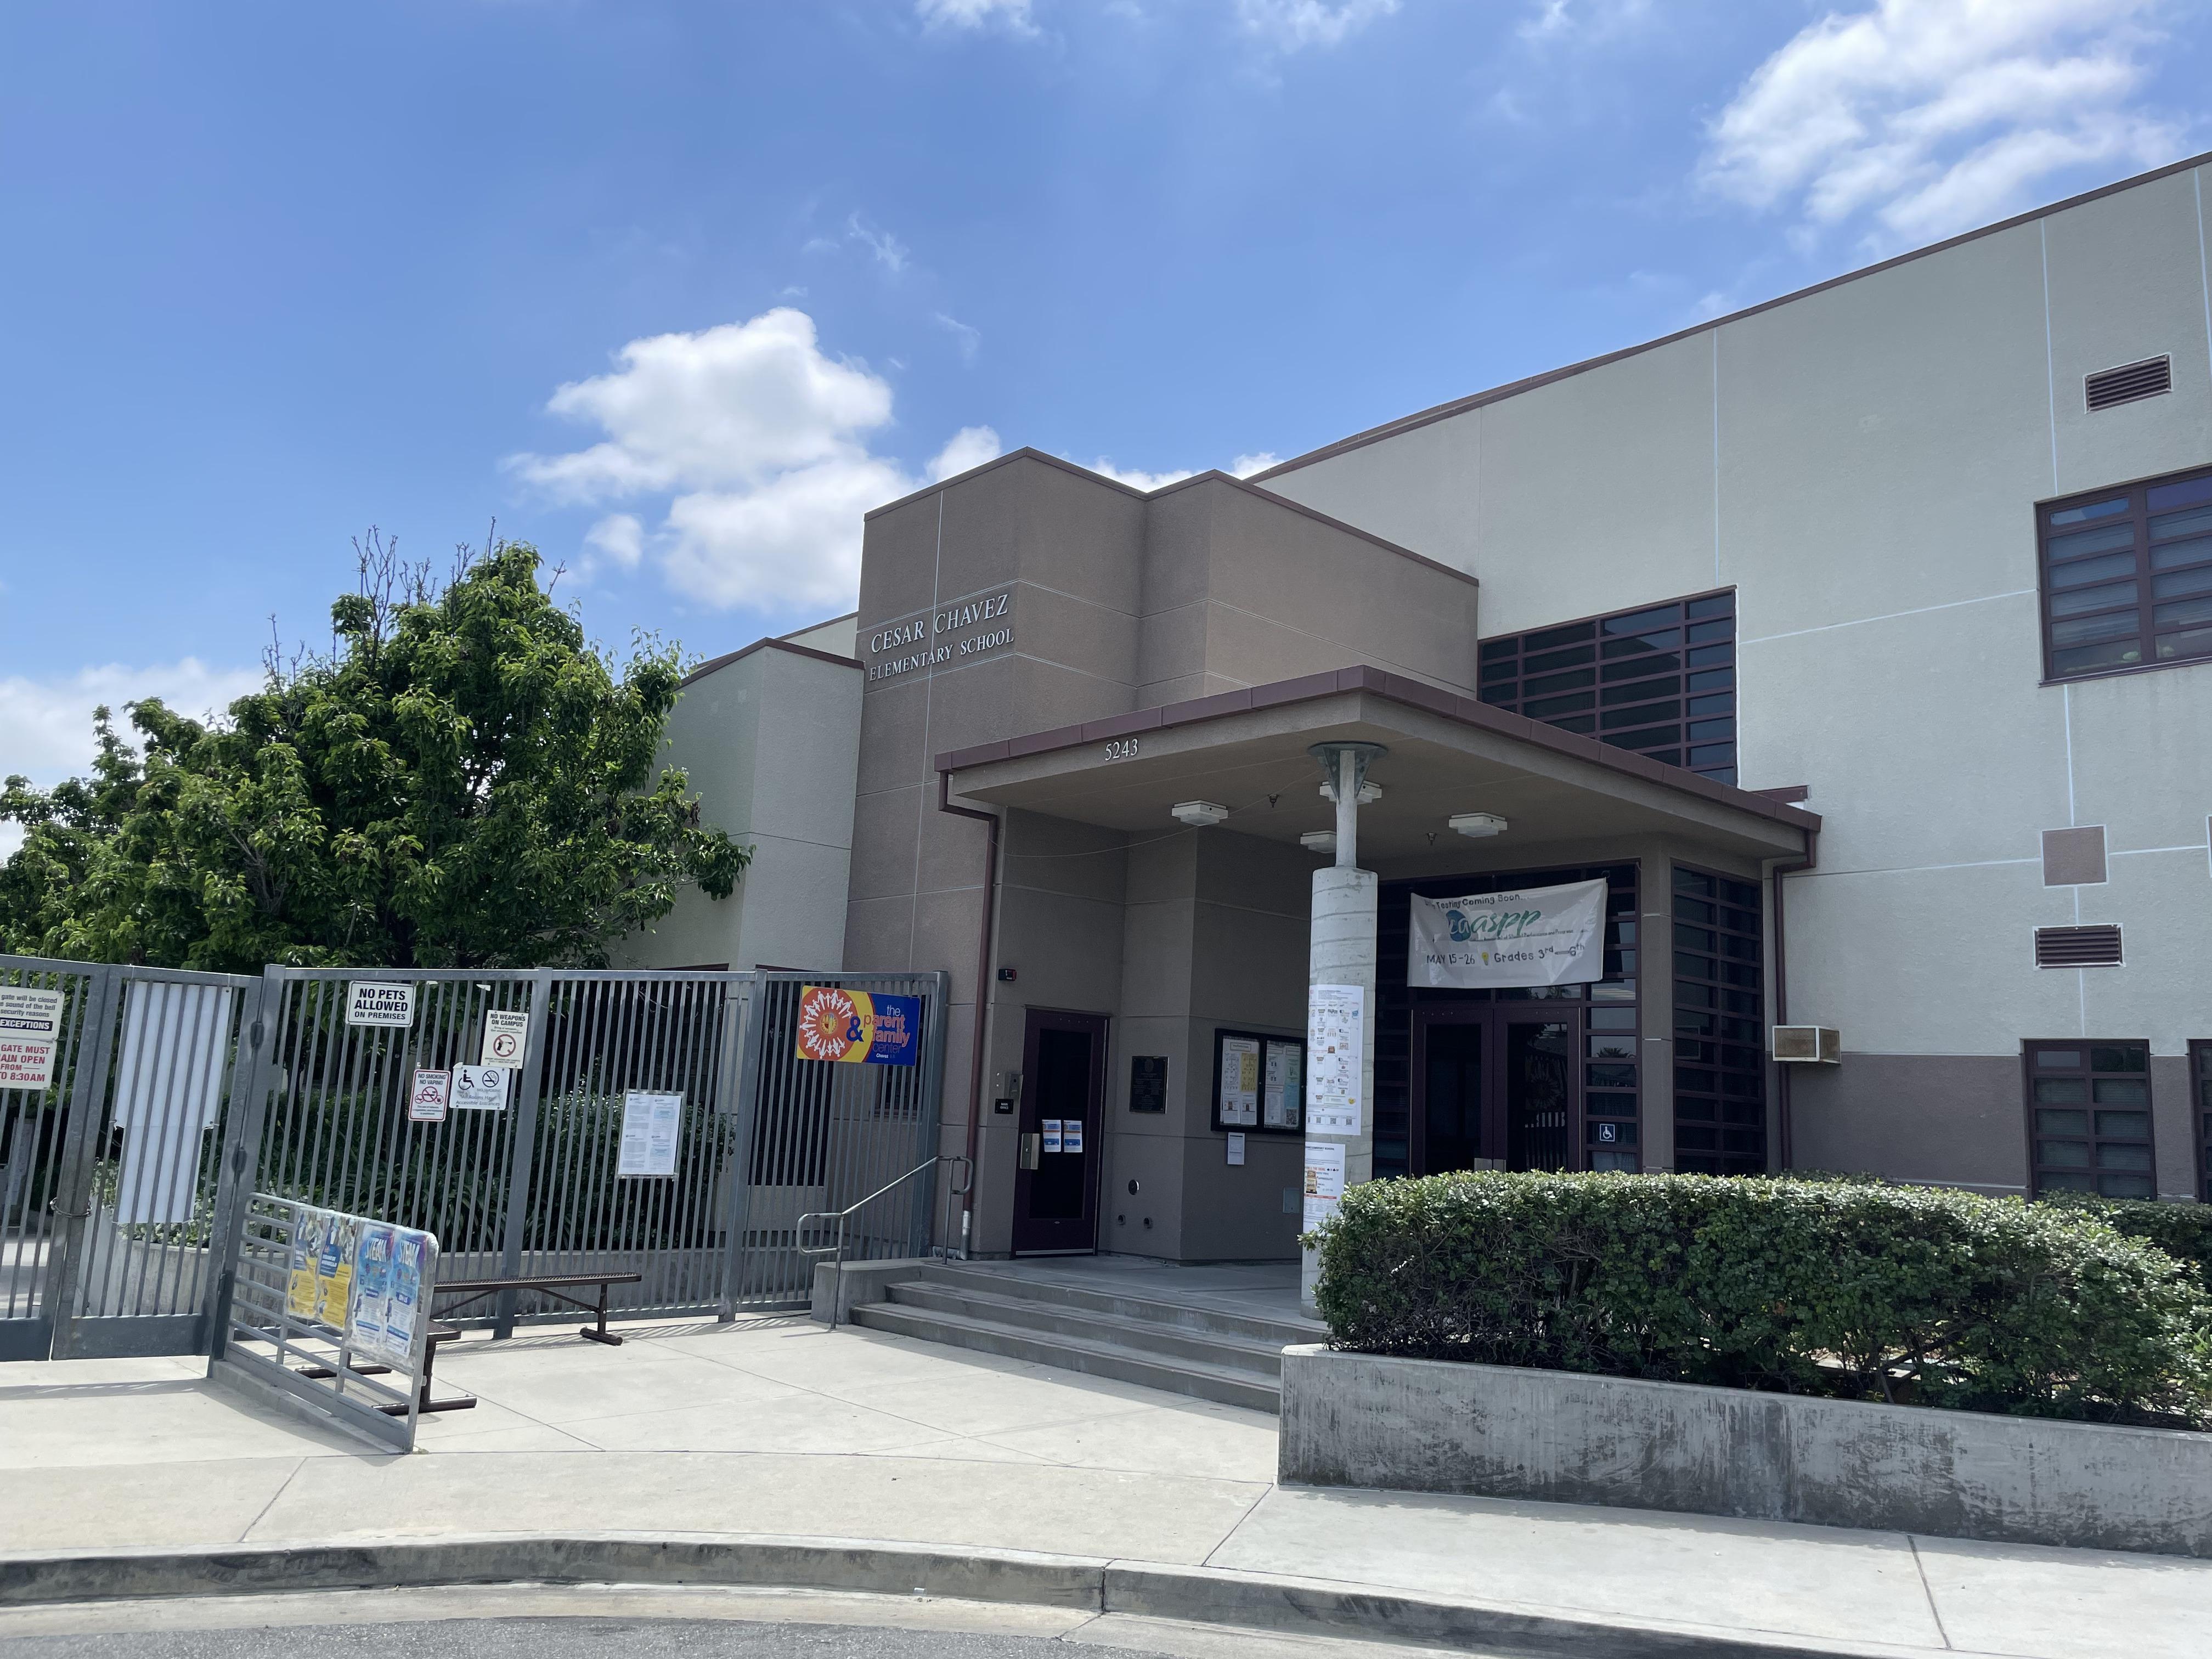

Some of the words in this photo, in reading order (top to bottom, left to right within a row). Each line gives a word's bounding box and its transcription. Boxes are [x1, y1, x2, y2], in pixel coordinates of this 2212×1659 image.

[871, 620, 924, 653] CESAR
[934, 594, 1009, 634] CHAVEZ
[868, 644, 954, 681] ELEMENTARY
[960, 628, 1014, 656] SCHOOL
[1105, 738, 1138, 761] 5243
[1462, 896, 1495, 905] Coming
[1427, 955, 1446, 964] MAY
[1494, 951, 1534, 962] Grades
[359, 988, 375, 998] NO
[378, 989, 405, 1000] PETS
[354, 1000, 408, 1012] ALLOWED
[887, 1005, 901, 1016] the
[368, 1012, 406, 1020] PREMISES
[864, 1014, 905, 1029] parent
[0, 1019, 49, 1030] EXCEPTIONS
[847, 1016, 864, 1042] &
[872, 1026, 911, 1047] family
[1, 1044, 22, 1052] GATE
[873, 1043, 900, 1053] center
[0, 1054, 17, 1062] AIN
[21, 1055, 45, 1064] OPEN
[10, 1072, 45, 1082] 8:30AM
